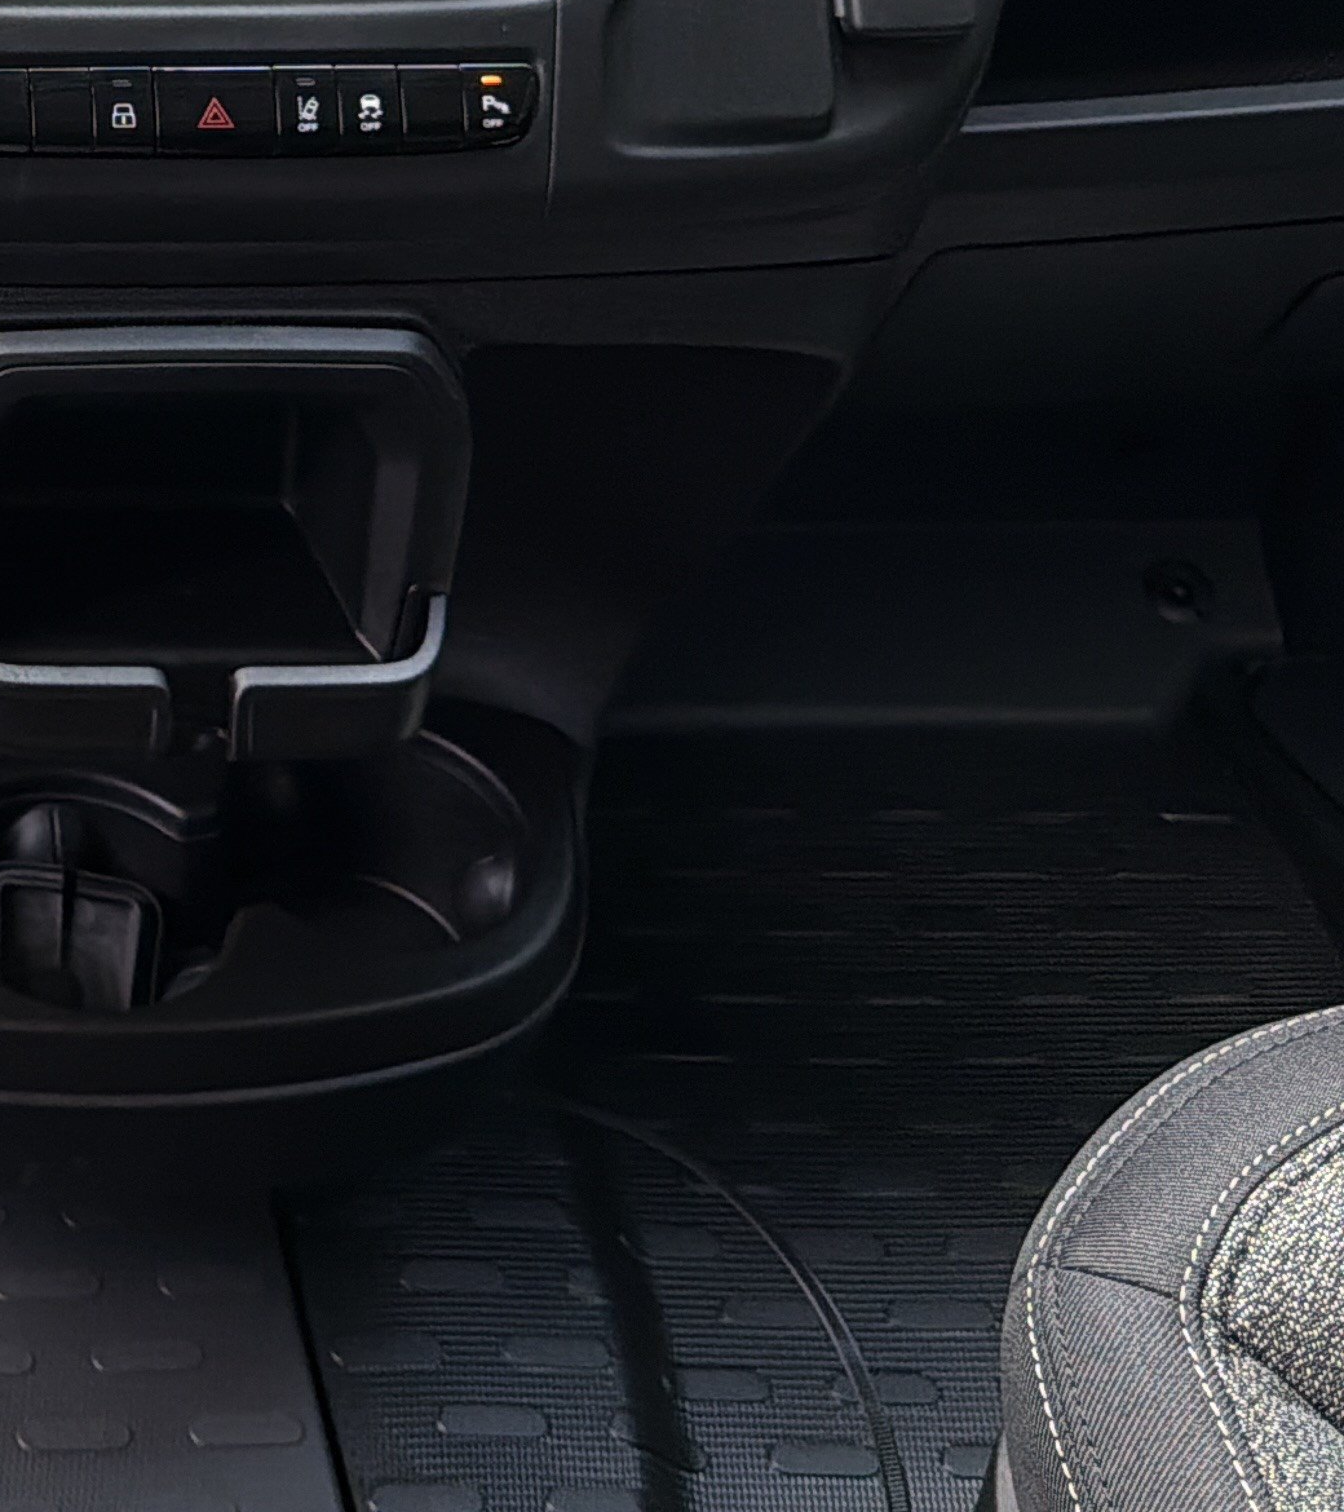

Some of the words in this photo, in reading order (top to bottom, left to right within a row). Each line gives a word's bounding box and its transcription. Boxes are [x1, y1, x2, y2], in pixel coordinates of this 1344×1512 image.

[297, 122, 320, 134] OFF
[359, 120, 383, 133] OFF
[482, 117, 506, 129] OFF
